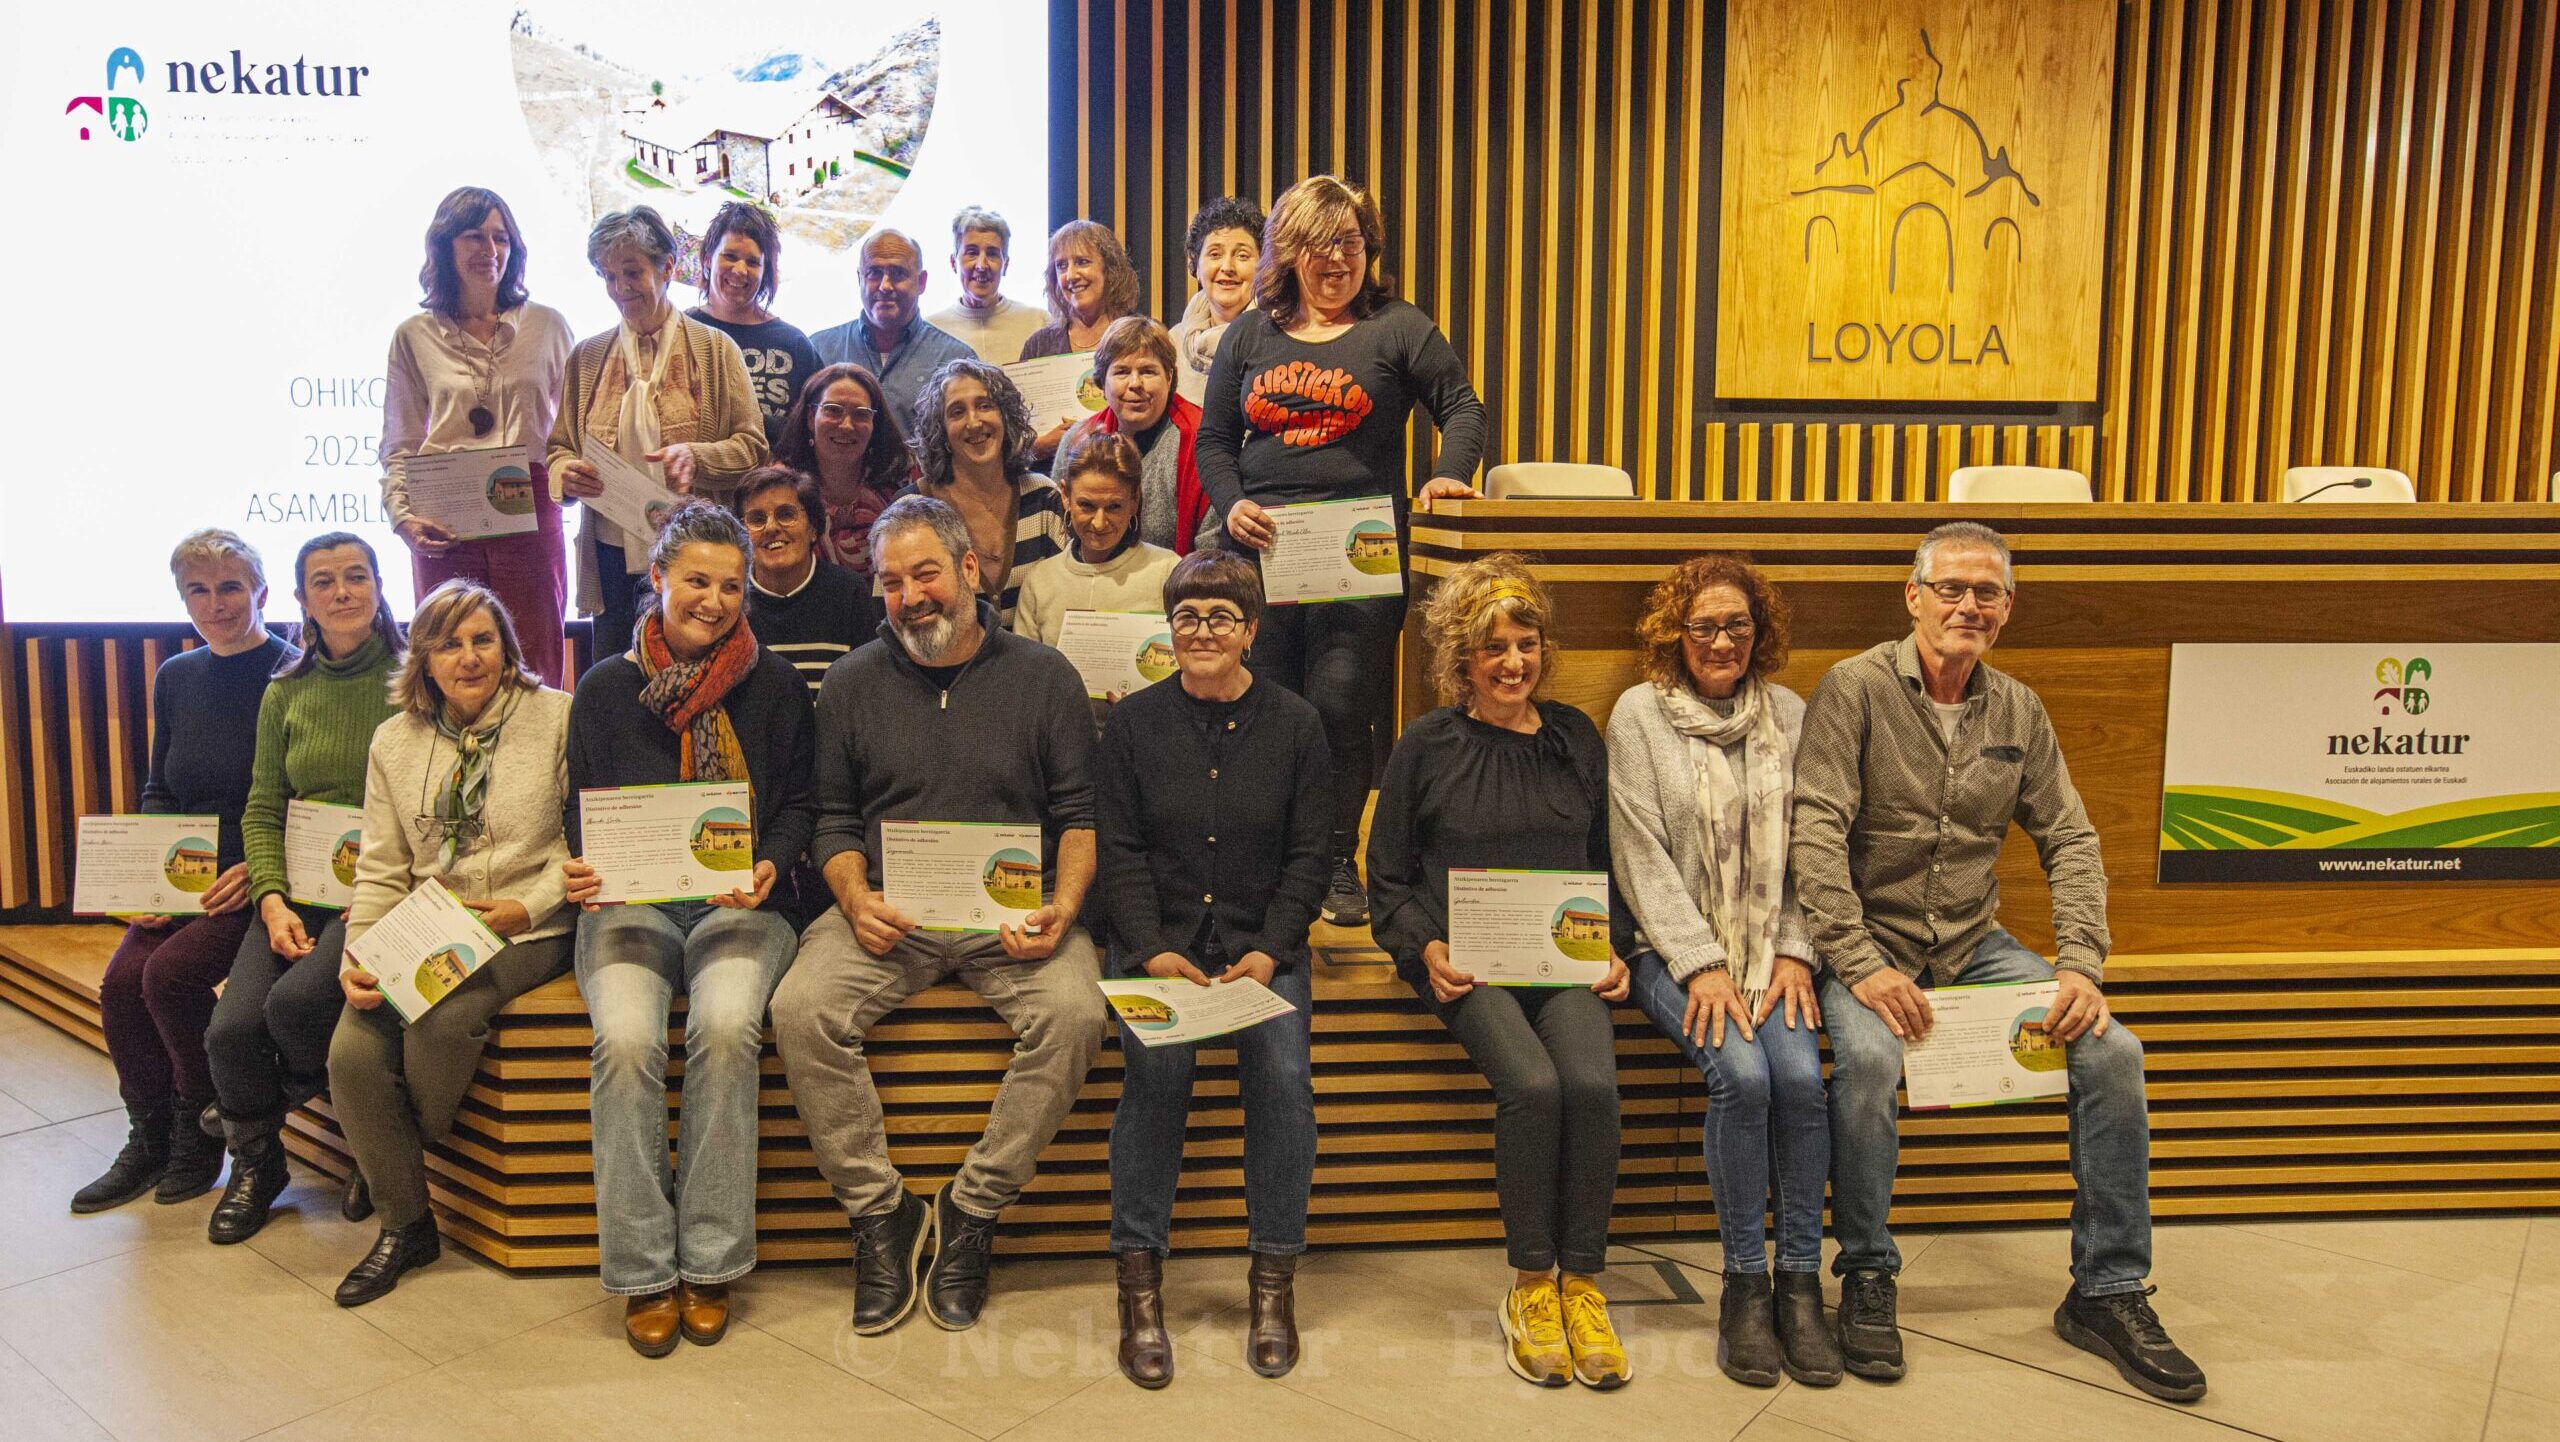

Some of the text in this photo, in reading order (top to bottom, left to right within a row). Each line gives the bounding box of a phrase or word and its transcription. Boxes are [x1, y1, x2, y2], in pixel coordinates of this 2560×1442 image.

[165, 49, 370, 97] nekatur
[1807, 321, 2011, 366] LOYOLA
[1252, 360, 1373, 417] LIPSTICK ON
[304, 435, 379, 466] 2025
[2326, 726, 2471, 755] nekatur
[2325, 777, 2360, 785] Asociación
[2369, 777, 2410, 786] alojamientos
[2442, 776, 2467, 784] Euskadi
[2318, 857, 2462, 871] www.nekatur.net
